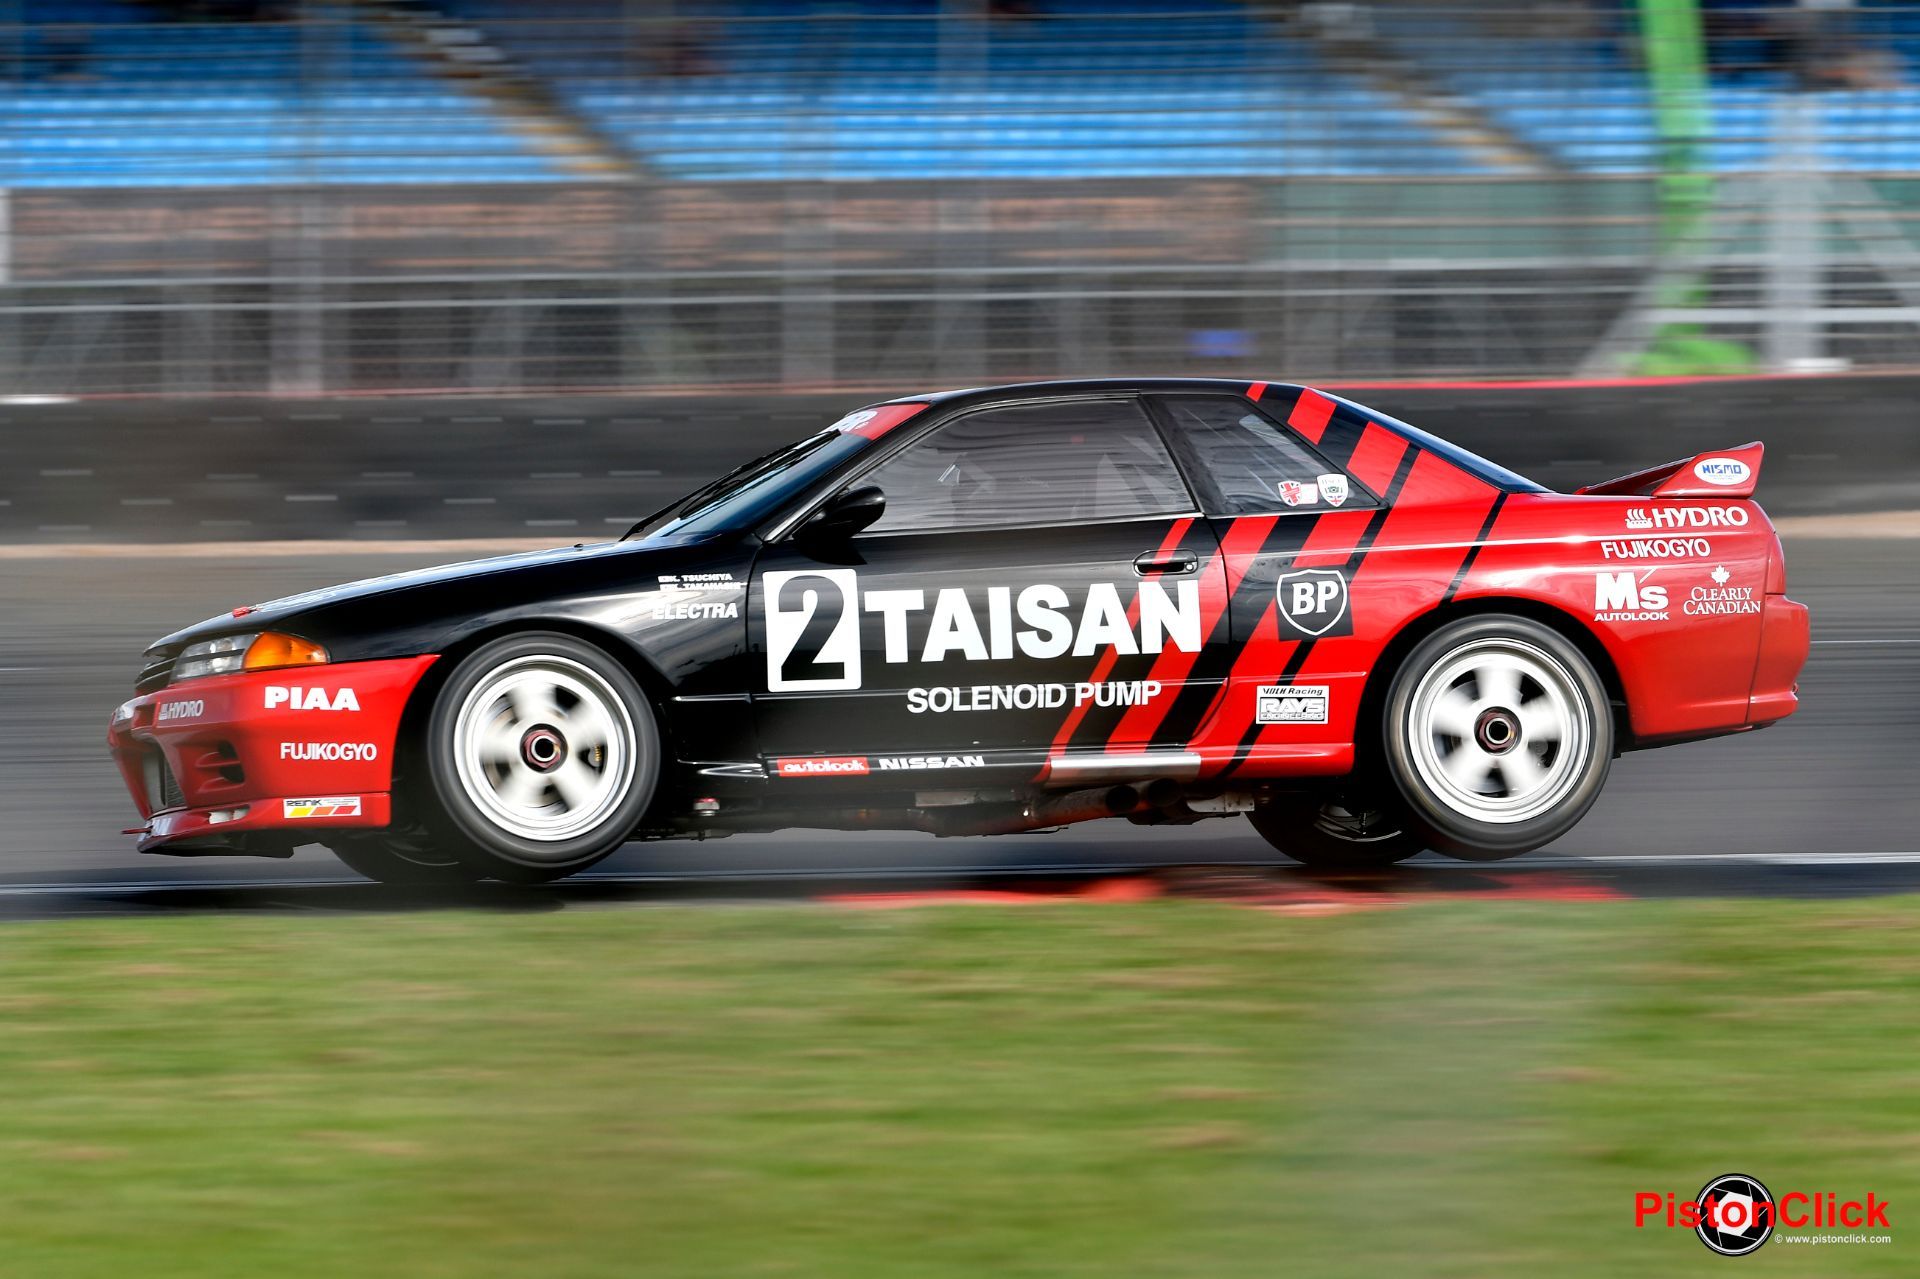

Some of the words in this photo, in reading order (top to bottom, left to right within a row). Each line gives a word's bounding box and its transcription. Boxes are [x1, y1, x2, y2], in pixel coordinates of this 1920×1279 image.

[1702, 464, 1742, 474] NISMO
[1652, 506, 1749, 528] HYDRO
[1601, 538, 1711, 559] FUJIKOGYO
[1291, 580, 1339, 615] BP
[652, 603, 739, 620] ELECTRA
[1594, 612, 1669, 622] AUTOLOOK
[778, 575, 845, 681] 2
[864, 580, 1202, 664] TAISAN
[264, 686, 361, 711] PIAA
[907, 684, 1067, 713] SOLENOID
[1075, 680, 1162, 707] PUMP
[1288, 688, 1323, 696] Racing
[167, 700, 204, 719] HYDRO
[280, 743, 378, 761] FUJIKOGYO
[784, 760, 865, 773] autolook
[878, 756, 985, 770] NISSAN
